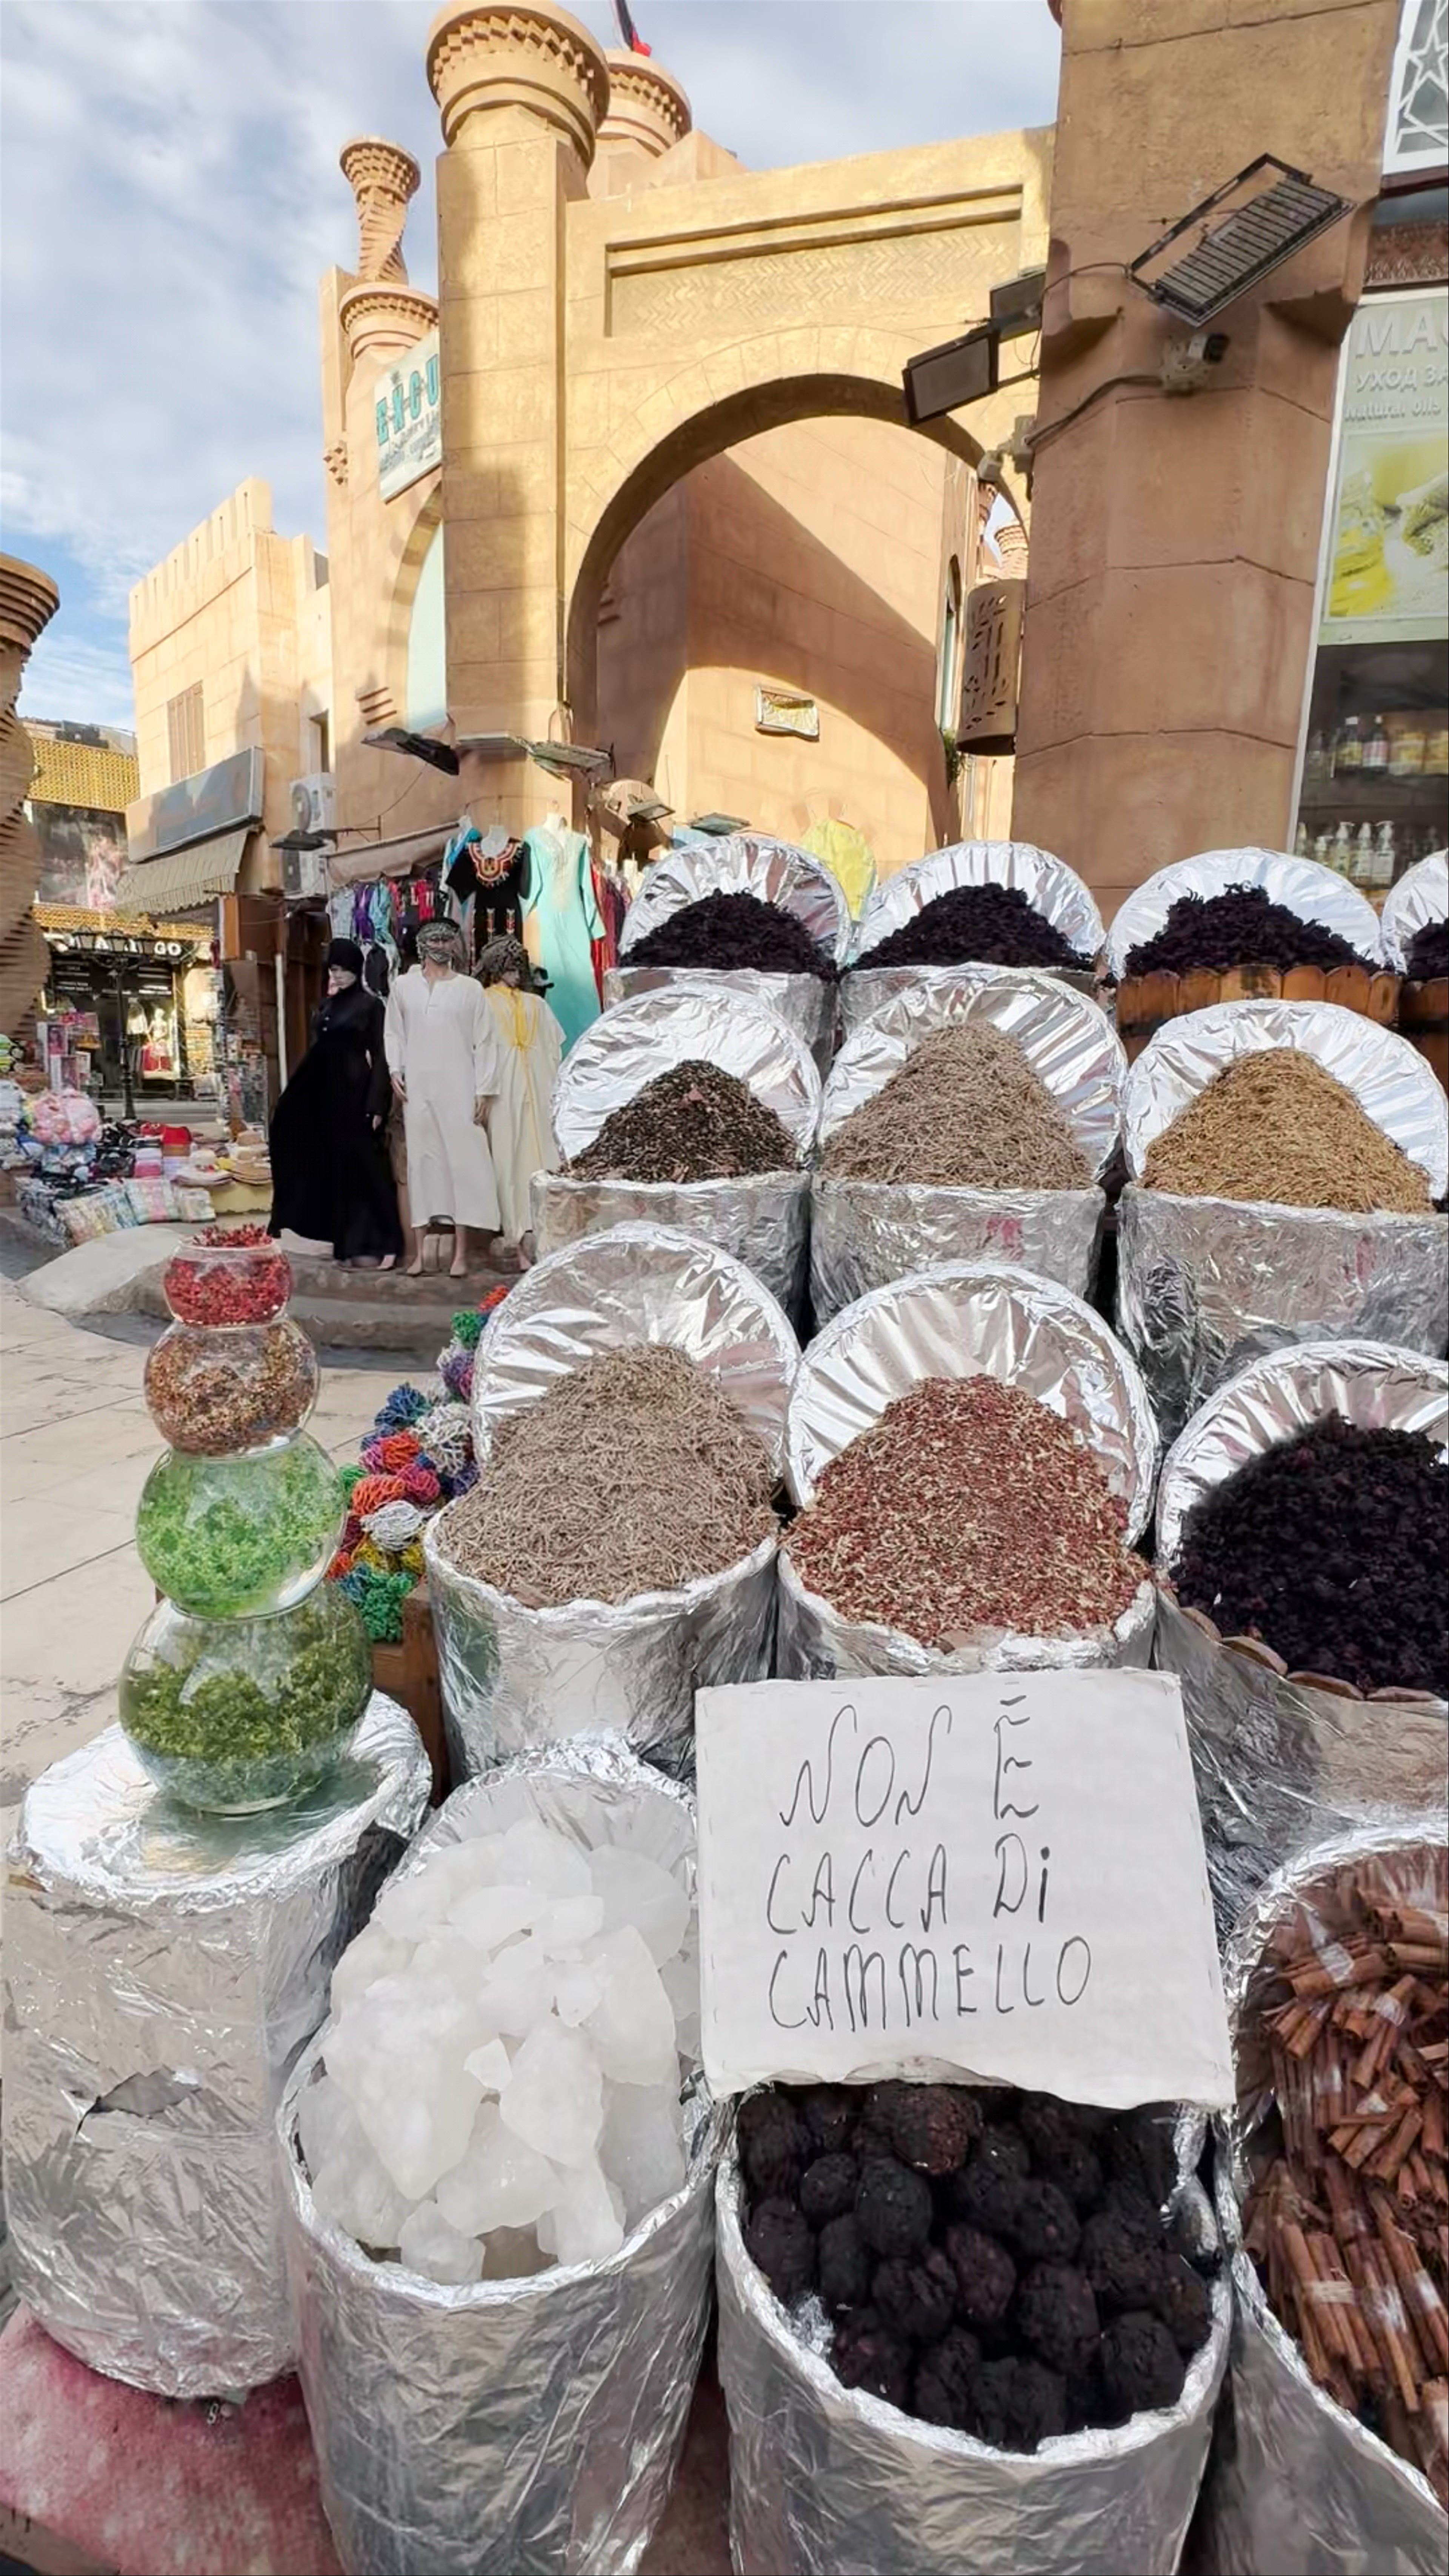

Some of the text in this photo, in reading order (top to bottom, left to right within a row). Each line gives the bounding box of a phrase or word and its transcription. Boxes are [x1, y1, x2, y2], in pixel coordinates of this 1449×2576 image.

[779, 1705, 952, 1827] NON
[767, 1844, 947, 1934] CACCA
[769, 1936, 1091, 2032] CAMMELLO
